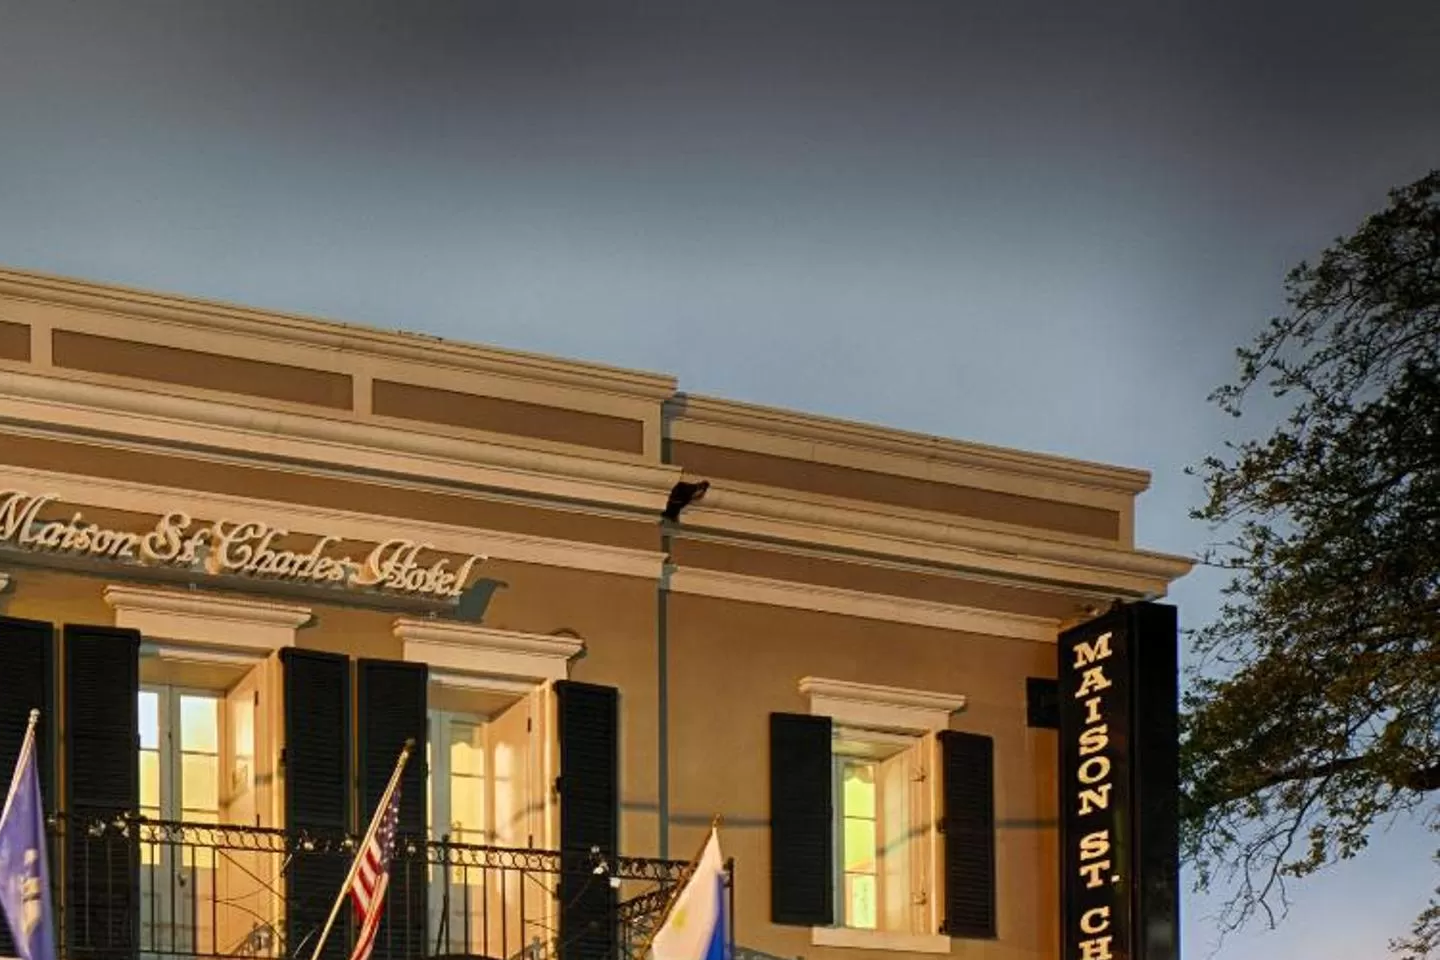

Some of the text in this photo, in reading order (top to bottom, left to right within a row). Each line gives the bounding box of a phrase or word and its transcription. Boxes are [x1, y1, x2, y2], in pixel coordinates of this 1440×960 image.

[205, 520, 351, 575] Charles
[348, 540, 488, 596] Hotel
[1073, 631, 1113, 816] MAISON
[1079, 832, 1119, 888] ST.
